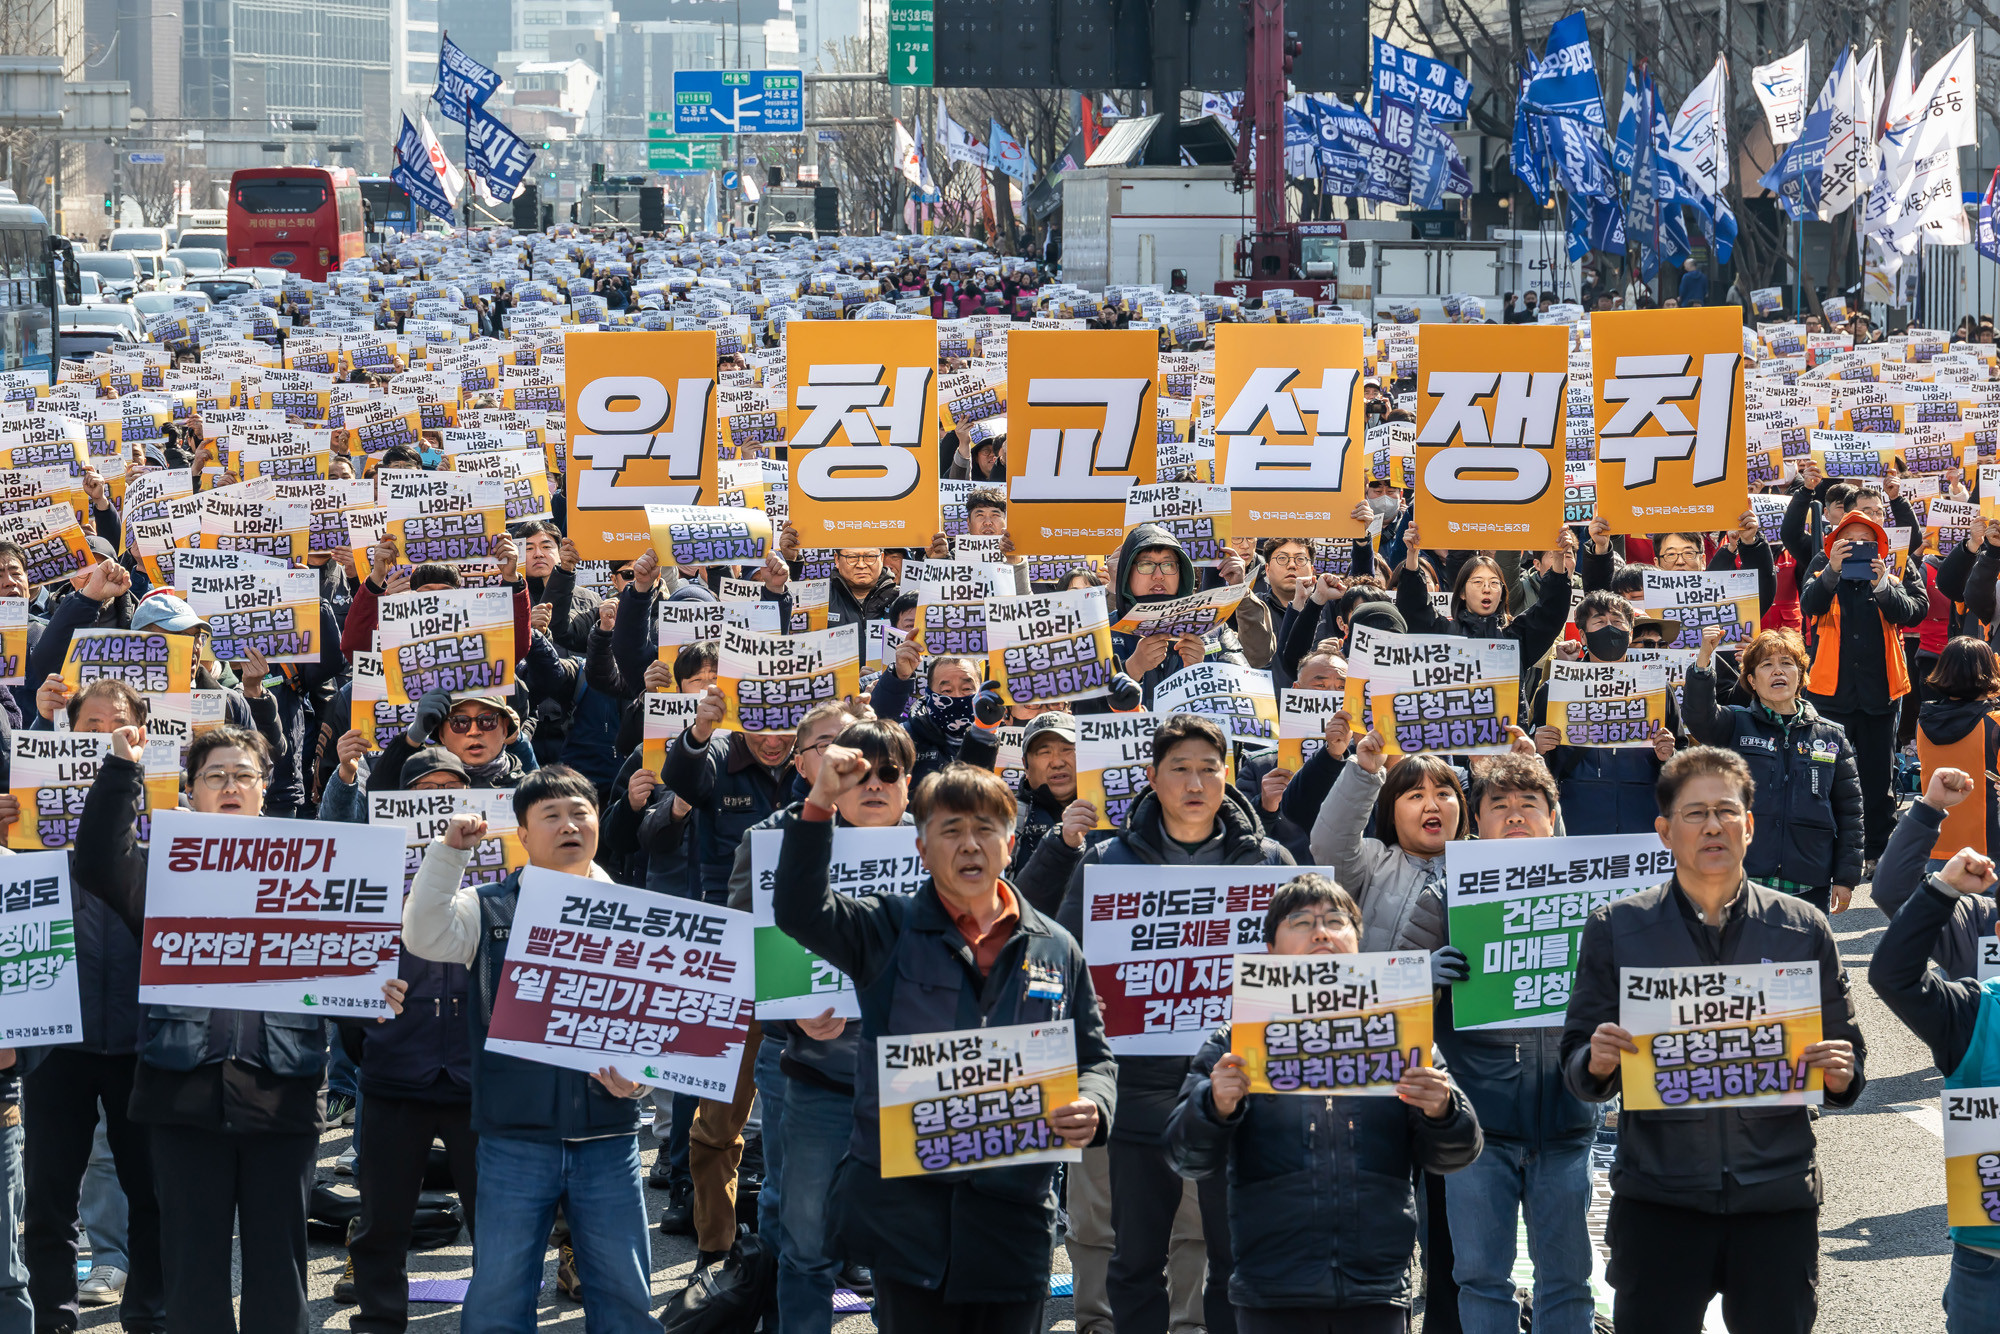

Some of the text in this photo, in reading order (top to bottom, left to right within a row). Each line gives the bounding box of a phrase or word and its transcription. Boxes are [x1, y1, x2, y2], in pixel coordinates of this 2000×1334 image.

[724, 74, 748, 84] 서울역
[764, 90, 798, 99] 서소문로
[681, 106, 707, 116] 소공로
[764, 109, 798, 119] 덕수궁길
[1031, 321, 1061, 329] 진짜사장
[1161, 355, 1189, 364] 진짜사장
[37, 400, 81, 412] 진짜사장
[720, 390, 754, 402] 진짜사장
[736, 399, 770, 413] 나와라!
[345, 401, 382, 416] 진짜사장
[365, 405, 399, 424] 나와라!
[1850, 406, 1893, 419] 원청교섭
[2, 417, 45, 434] 진짜사장
[358, 418, 408, 439] 원청교섭
[729, 413, 777, 430] 원청교섭
[1215, 367, 1361, 491] 섭
[1599, 352, 1741, 489] 취
[23, 428, 66, 443] 나와라!
[361, 430, 418, 453] 쟁취하자!
[789, 363, 934, 502] 청
[1011, 379, 1151, 503] 교
[1416, 371, 1568, 503] 쟁
[1813, 431, 1854, 441] 진짜사장
[572, 376, 716, 511] 원
[1834, 440, 1871, 450] 나와라!
[1904, 444, 1953, 460] 원청교섭
[11, 444, 75, 465] 원청교섭
[458, 454, 501, 473] 진짜사장
[1824, 450, 1879, 463] 원청교섭
[1825, 462, 1888, 477] 쟁취하자!
[275, 482, 327, 499] 진짜사장
[391, 480, 448, 500] 진짜사장
[1129, 485, 1181, 505] 진짜사장
[206, 499, 264, 519] 진짜사장
[419, 493, 473, 514] 나와라!
[1152, 497, 1203, 517] 나와라!
[1646, 505, 1715, 515] 전국금속노동조합
[234, 517, 284, 535] 나와라!
[404, 513, 483, 539] 원청교섭
[836, 519, 906, 531] 전국금속노동조합
[1262, 511, 1331, 521] 전국금속노동조합
[669, 521, 749, 541] 원청교섭
[1053, 528, 1123, 537] 전국금속노동조합
[1461, 522, 1530, 532] 전국금속노동조합
[217, 535, 291, 555] 원청교섭
[672, 538, 764, 565] 쟁취하자!
[178, 553, 239, 569] 진짜사장
[191, 575, 256, 593] 진짜사장
[941, 582, 996, 602] 나와라!
[1647, 575, 1703, 592] 진짜사장
[225, 587, 283, 610] 나와라!
[1676, 585, 1726, 605] 나와라!
[382, 597, 440, 622] 진짜사장
[664, 606, 726, 624] 진짜사장
[988, 598, 1051, 625] 진짜사장
[1662, 604, 1737, 627] 원청교섭
[209, 608, 295, 637] 원청교섭
[410, 608, 469, 640] 나와라!
[1018, 610, 1081, 642] 나와라!
[398, 633, 485, 673] 원청교섭
[724, 630, 795, 657] 진짜사장
[1003, 633, 1097, 675] 원청교섭
[1495, 643, 1516, 651] 민주노총
[758, 651, 823, 677] 나와라!
[1374, 643, 1451, 666] 진짜사장
[1008, 660, 1112, 702] 쟁취하자!
[1156, 665, 1214, 699] 진짜사장
[1413, 659, 1481, 688] 나와라!
[1554, 665, 1615, 681] 진짜사장
[738, 673, 835, 705] 원청교섭
[1184, 678, 1241, 699] 나와라!
[1584, 678, 1637, 699] 나와라!
[1394, 686, 1494, 721] 원청교섭
[1567, 699, 1646, 722] 원청교섭
[1080, 716, 1160, 742] 진짜사장
[1396, 717, 1508, 753] 쟁취하자!
[1567, 718, 1657, 745] 쟁취하자!
[16, 738, 99, 760] 진짜사장
[374, 797, 455, 819] 진짜사장
[168, 837, 337, 873] 중대재해가
[1458, 848, 1676, 896] 모든 건설노동자를 위한
[0, 875, 60, 914] 설로
[255, 878, 388, 914] 감소되는
[559, 895, 727, 945] 건설노동자도
[1131, 918, 1231, 951] 임금체불
[525, 926, 736, 983] 빨간날 쉴 수 있는
[1398, 957, 1425, 966] 민주노총
[1484, 933, 1570, 974] 미래를
[1240, 961, 1340, 989] 진짜사장
[1786, 967, 1813, 976] 민주노총
[1292, 980, 1379, 1014] 나와라!
[1627, 974, 1726, 1001] 진짜사장
[321, 995, 387, 1009] 전국건설노동조합
[552, 972, 644, 1020] 권리가
[645, 988, 743, 1029] 보장된
[1679, 992, 1766, 1026] 나와라!
[6, 1022, 73, 1039] 전국건설노동조합
[1042, 1027, 1069, 1037] 민주노총
[1265, 1012, 1396, 1057] 원청교섭
[885, 1036, 983, 1070] 진짜사장
[1652, 1023, 1784, 1067] 원청교섭
[661, 1069, 727, 1093] 전국건설노동조합
[938, 1053, 1024, 1092] 나와라!
[1655, 1058, 1808, 1105] 쟁취하자!
[912, 1084, 1042, 1134] 원청교섭
